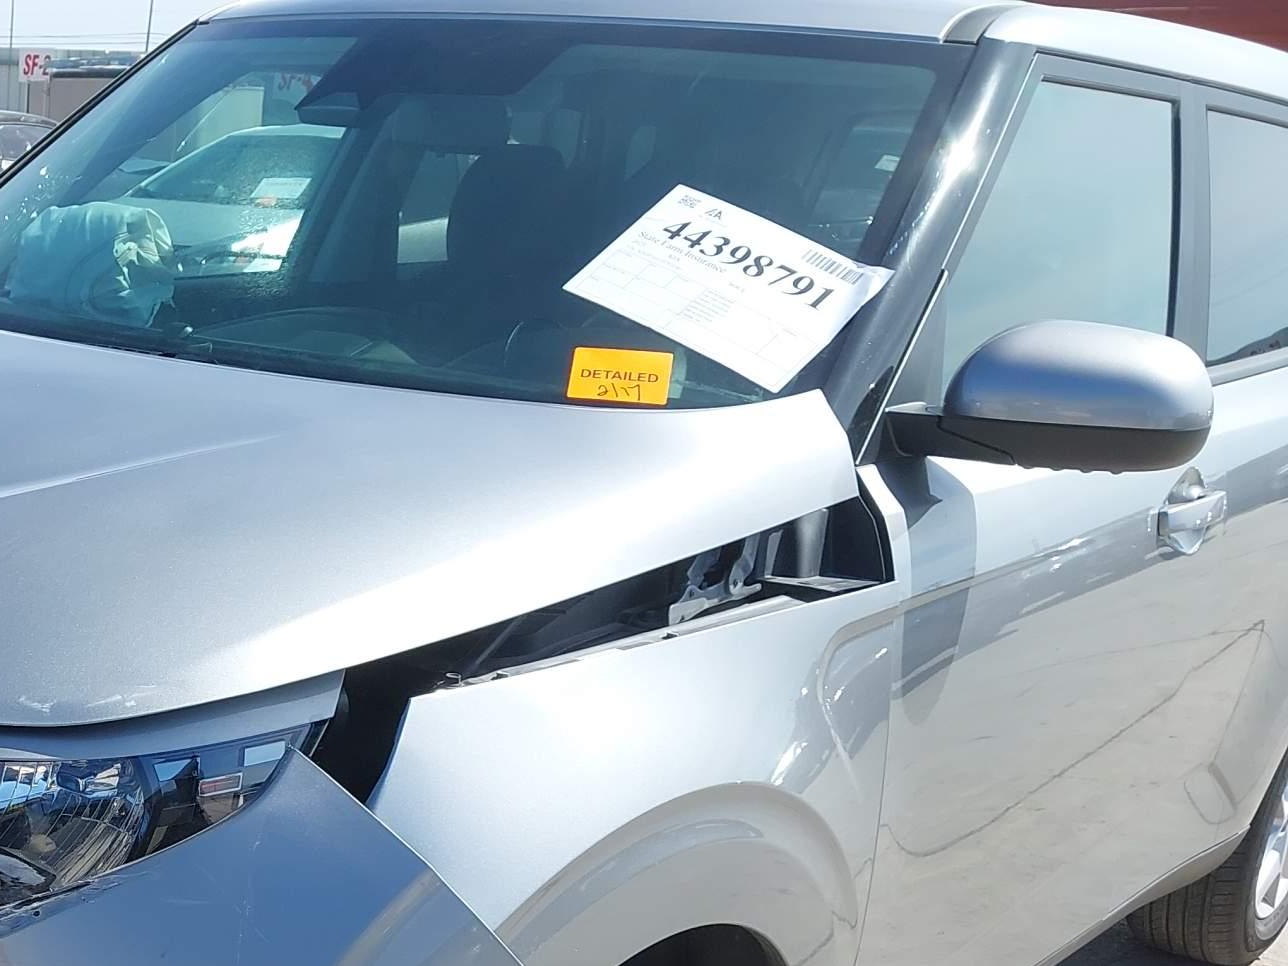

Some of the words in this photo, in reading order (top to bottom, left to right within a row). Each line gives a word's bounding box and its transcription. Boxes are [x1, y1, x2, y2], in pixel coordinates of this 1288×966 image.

[23, 53, 52, 76] SF-2
[662, 221, 834, 310] 44398791
[580, 368, 659, 383] DETAILED
